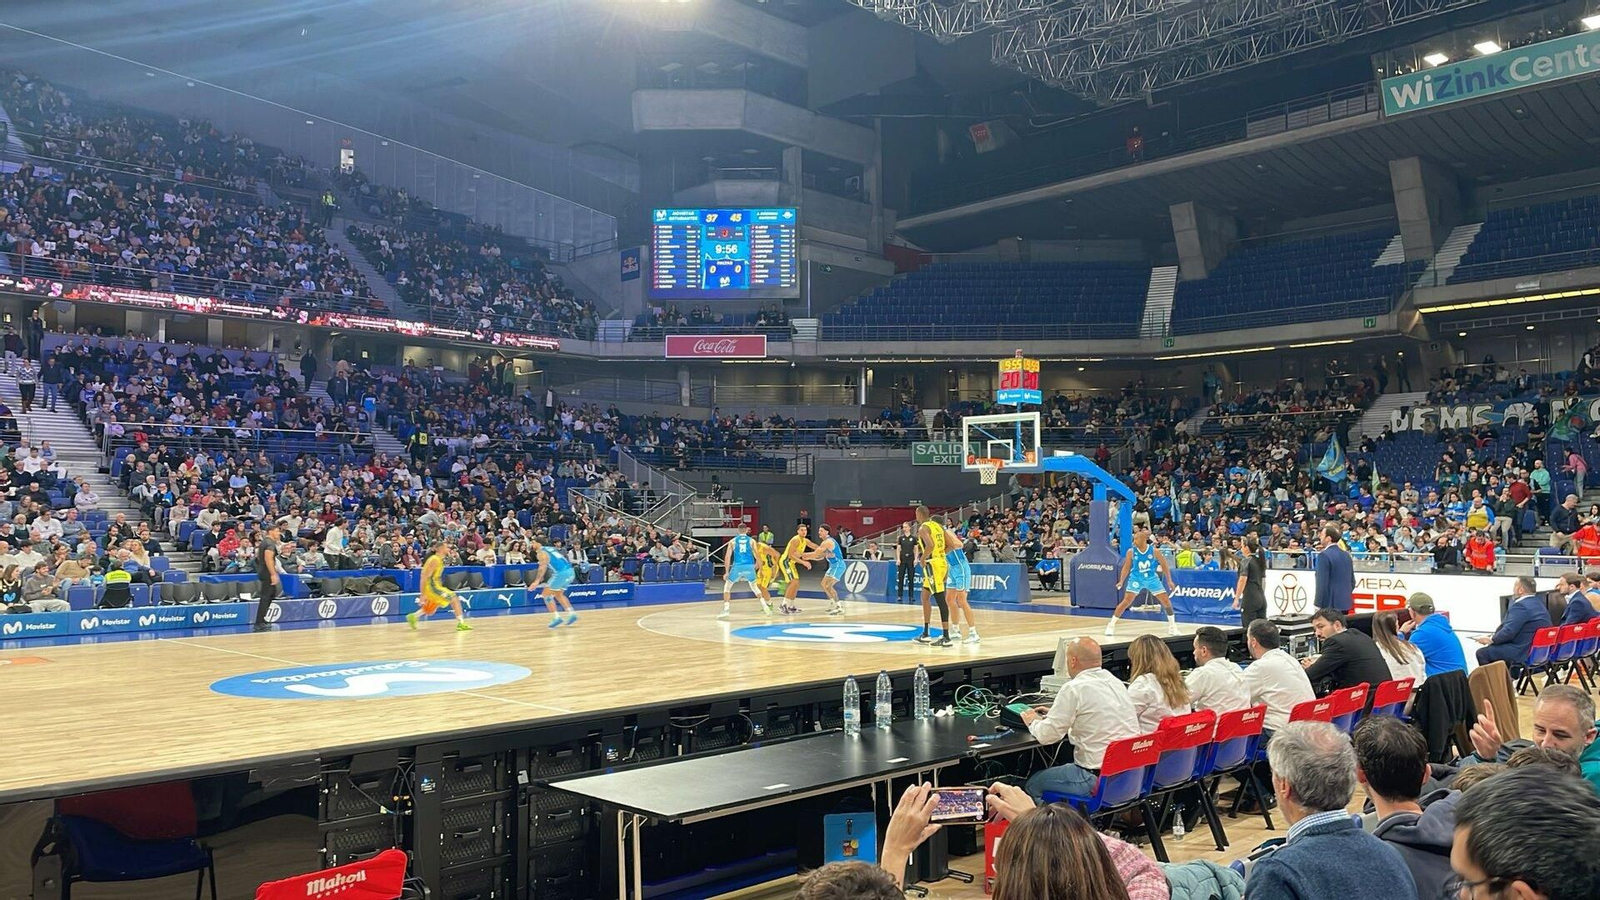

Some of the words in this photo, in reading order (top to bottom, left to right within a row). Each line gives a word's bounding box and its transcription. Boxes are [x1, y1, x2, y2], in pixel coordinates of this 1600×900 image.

[705, 213, 718, 223] 37
[730, 213, 742, 222] 45
[715, 244, 738, 254] 9:56
[916, 444, 976, 455] SALIDA
[933, 455, 960, 464] EXIT
[846, 561, 868, 593] hp
[319, 599, 337, 618] hp
[372, 596, 389, 615] hp
[158, 615, 186, 623] Movistar
[212, 612, 238, 620] Movistar
[25, 622, 57, 630] Movistar
[101, 618, 131, 626] Movistar
[306, 869, 367, 896] Mahou
